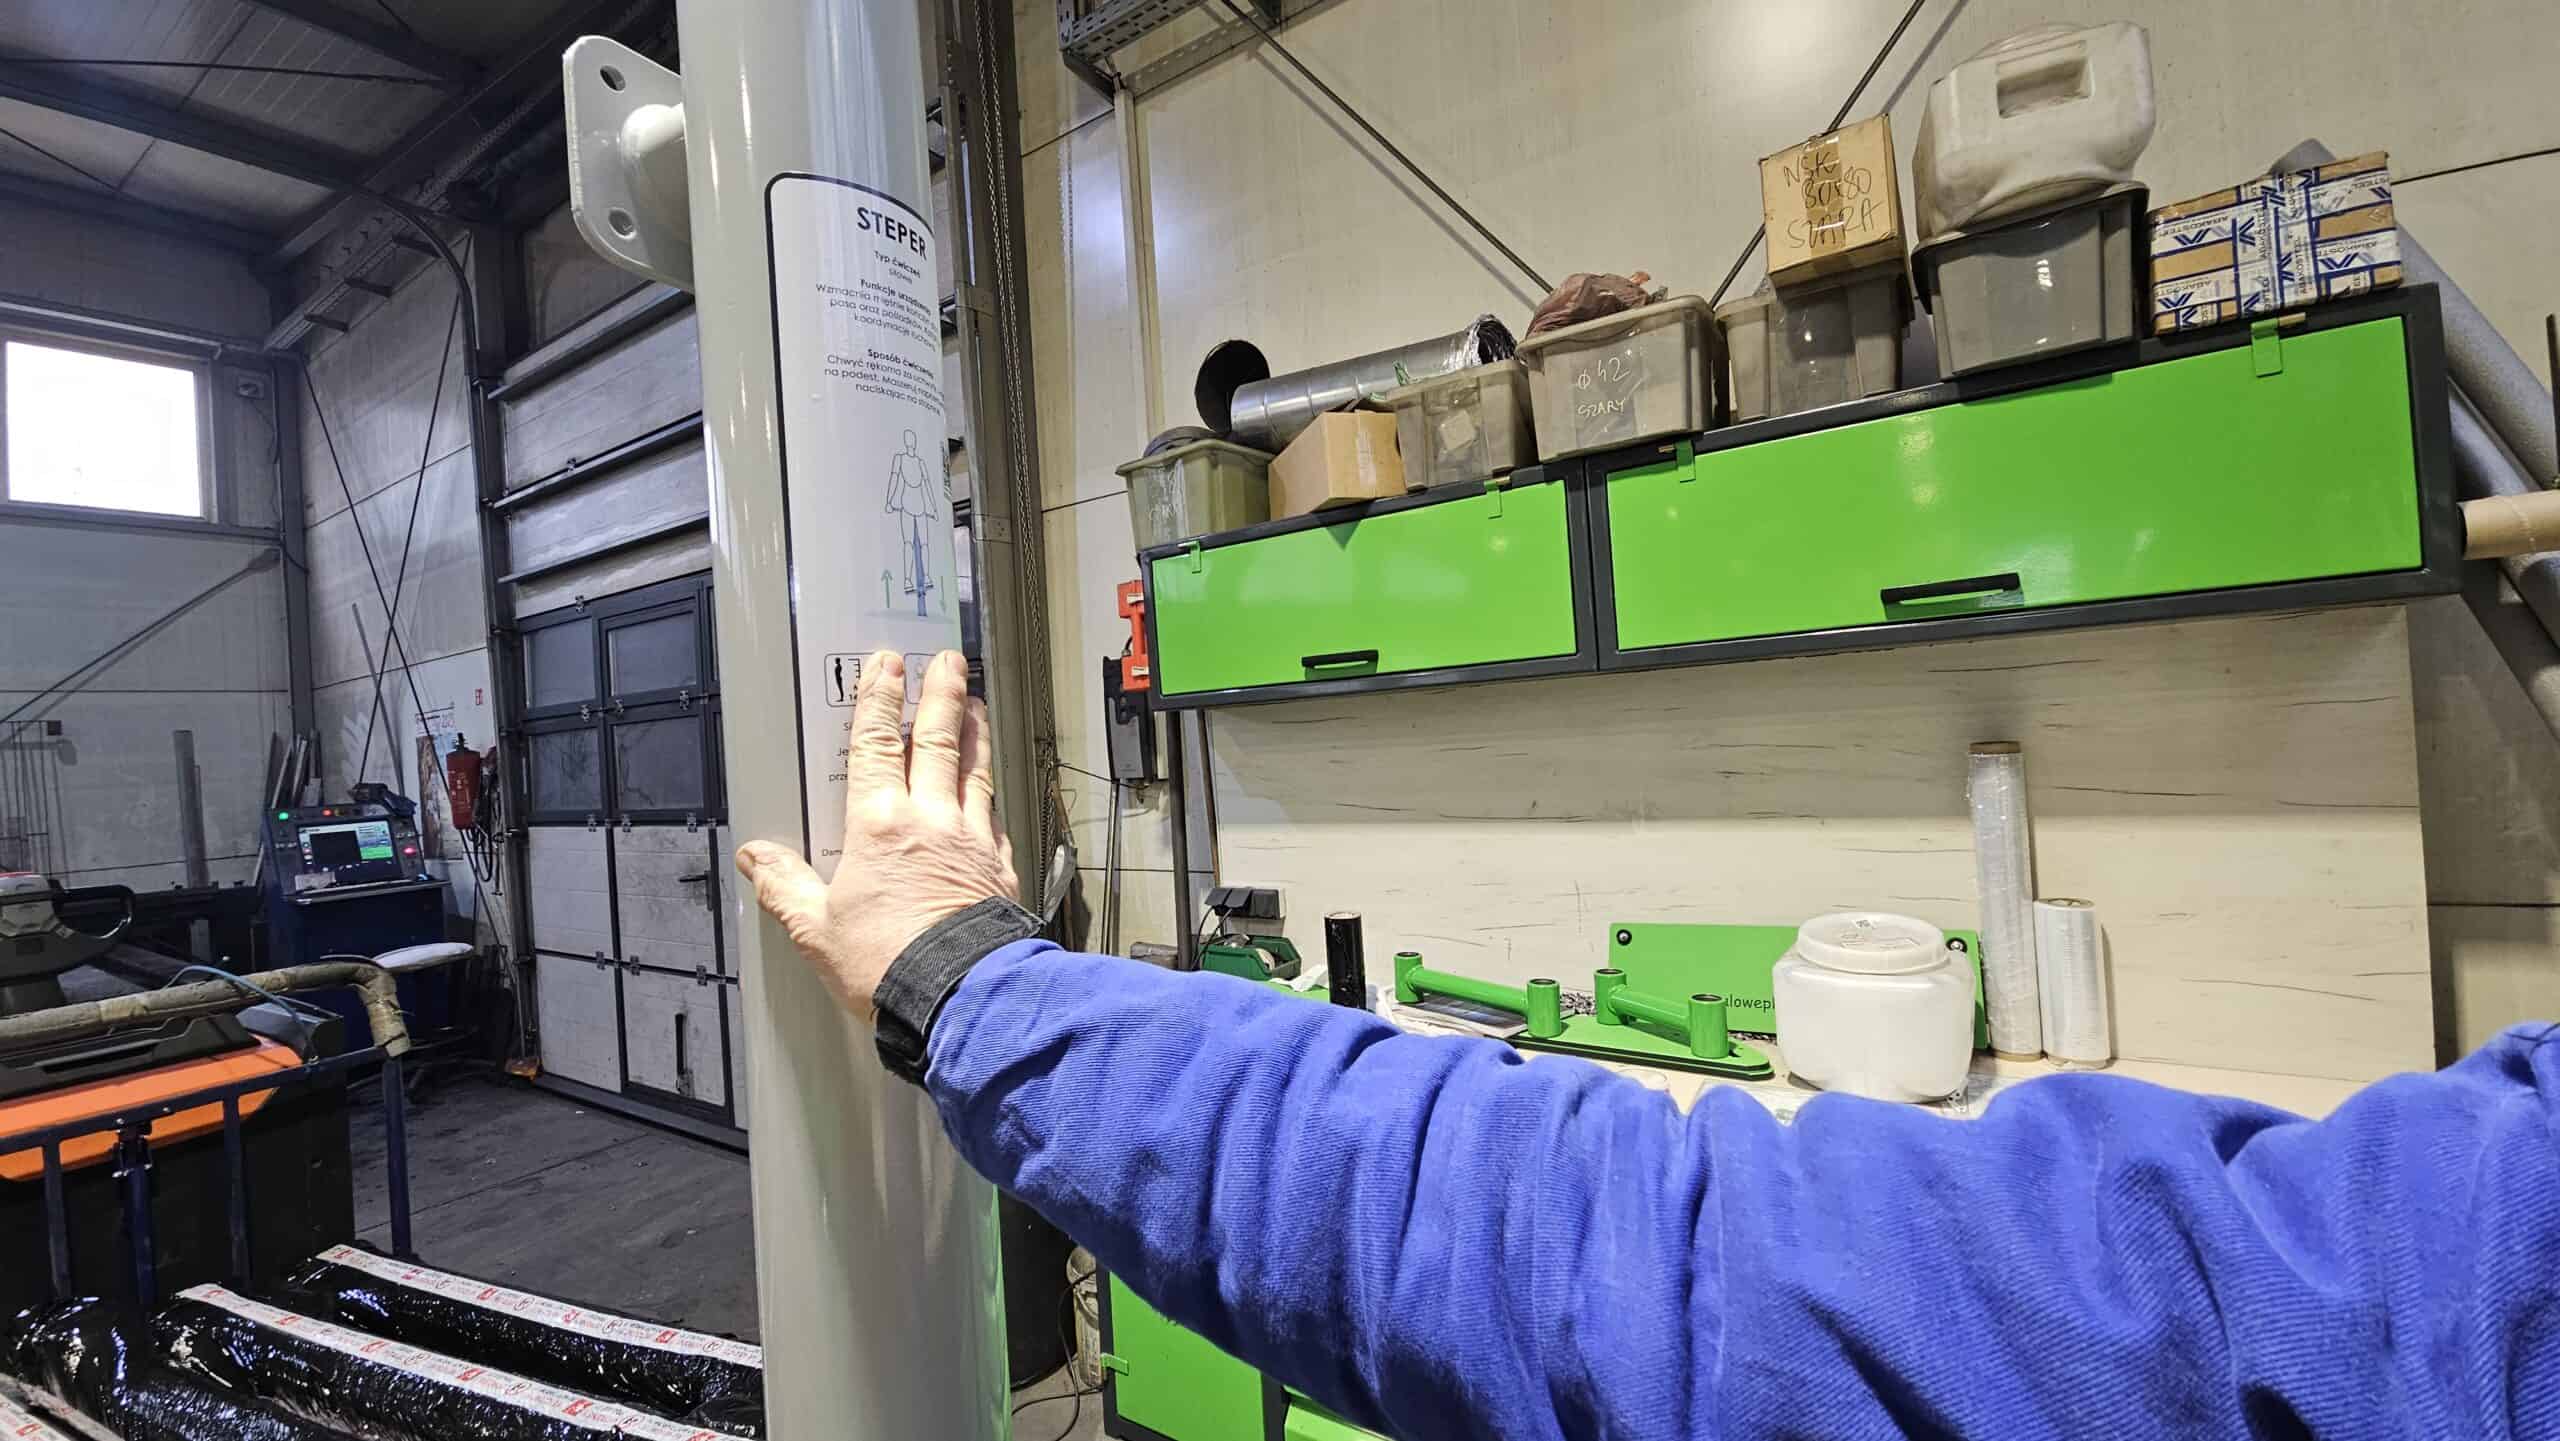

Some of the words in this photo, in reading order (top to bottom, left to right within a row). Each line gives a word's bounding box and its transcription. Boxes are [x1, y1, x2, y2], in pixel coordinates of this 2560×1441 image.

[857, 206, 927, 260] STEPER
[816, 283, 871, 300] Wzmacnia
[860, 279, 896, 297] Funkcje
[830, 298, 857, 309] pasa
[859, 303, 880, 314] oraz
[827, 354, 864, 368] Chwyć
[867, 348, 901, 364] Sposób
[824, 368, 839, 377] na
[1597, 357, 1631, 382] 42
[1577, 397, 1627, 418] SZARY
